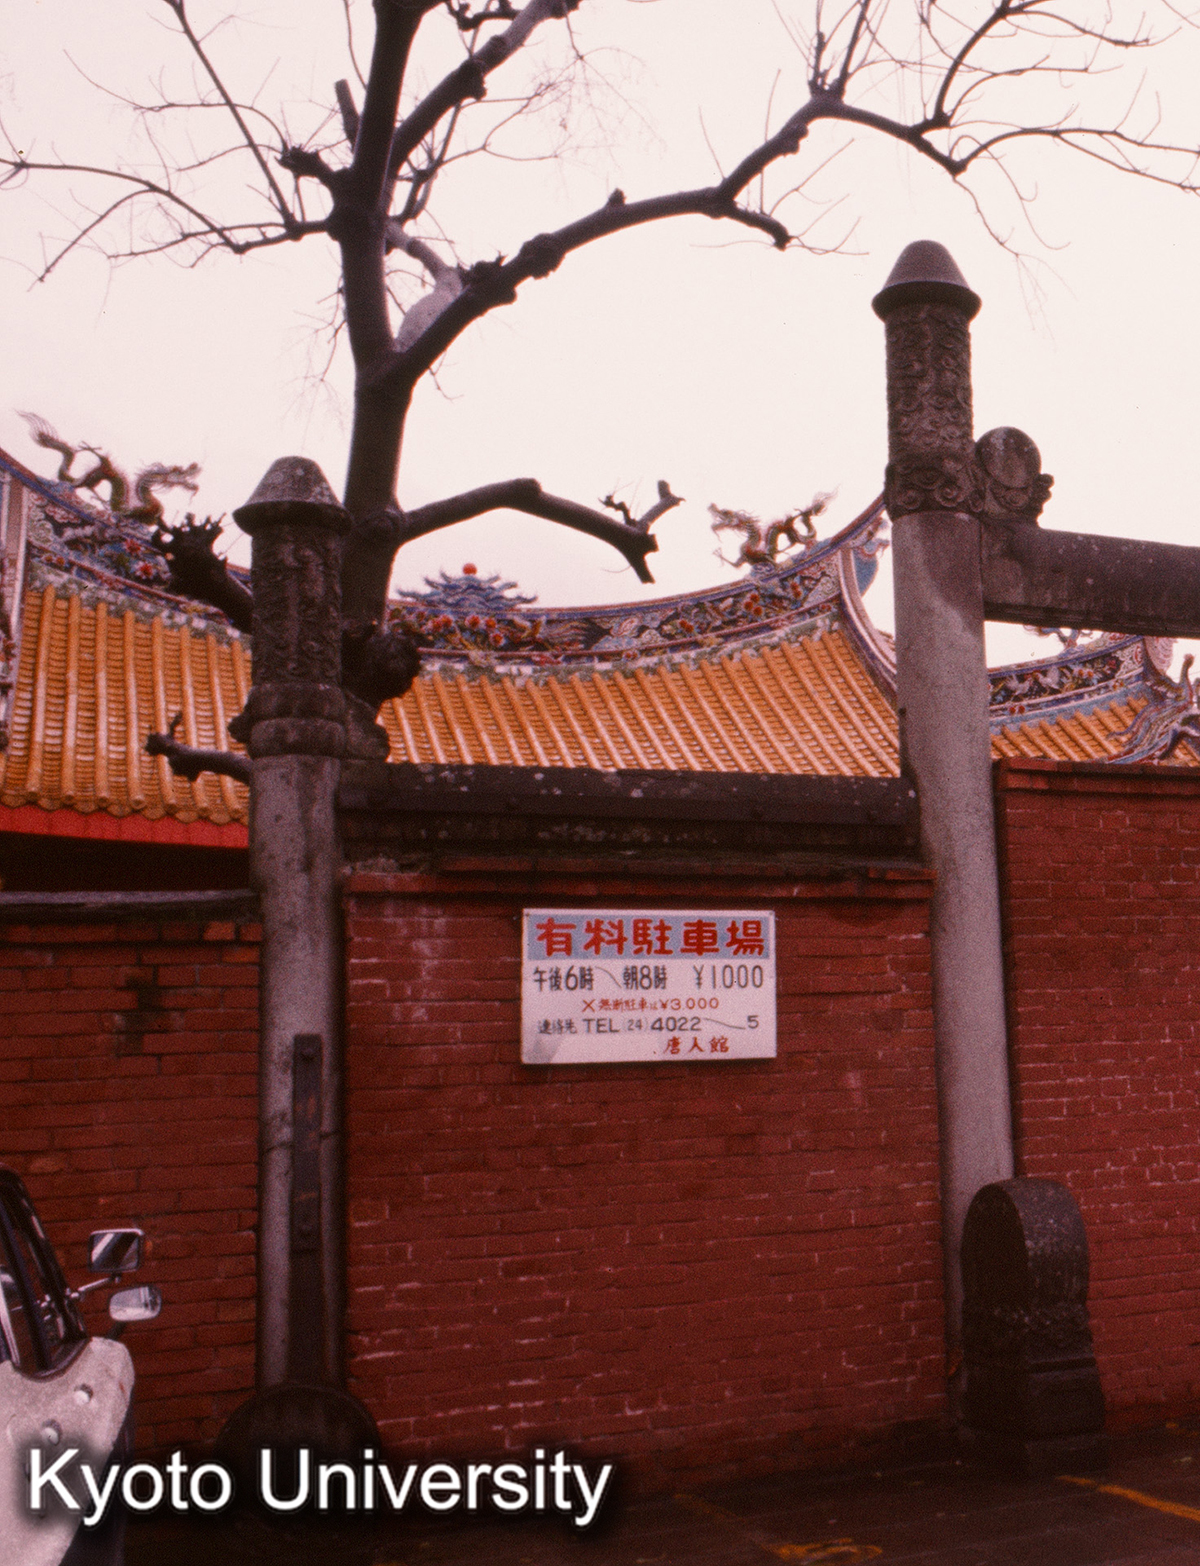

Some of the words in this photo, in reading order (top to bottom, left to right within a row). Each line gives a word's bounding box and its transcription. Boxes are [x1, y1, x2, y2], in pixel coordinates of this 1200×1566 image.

[535, 917, 765, 956] 有料駐車場
[583, 1017, 620, 1033] TEL
[664, 1035, 730, 1055] 唐人館
